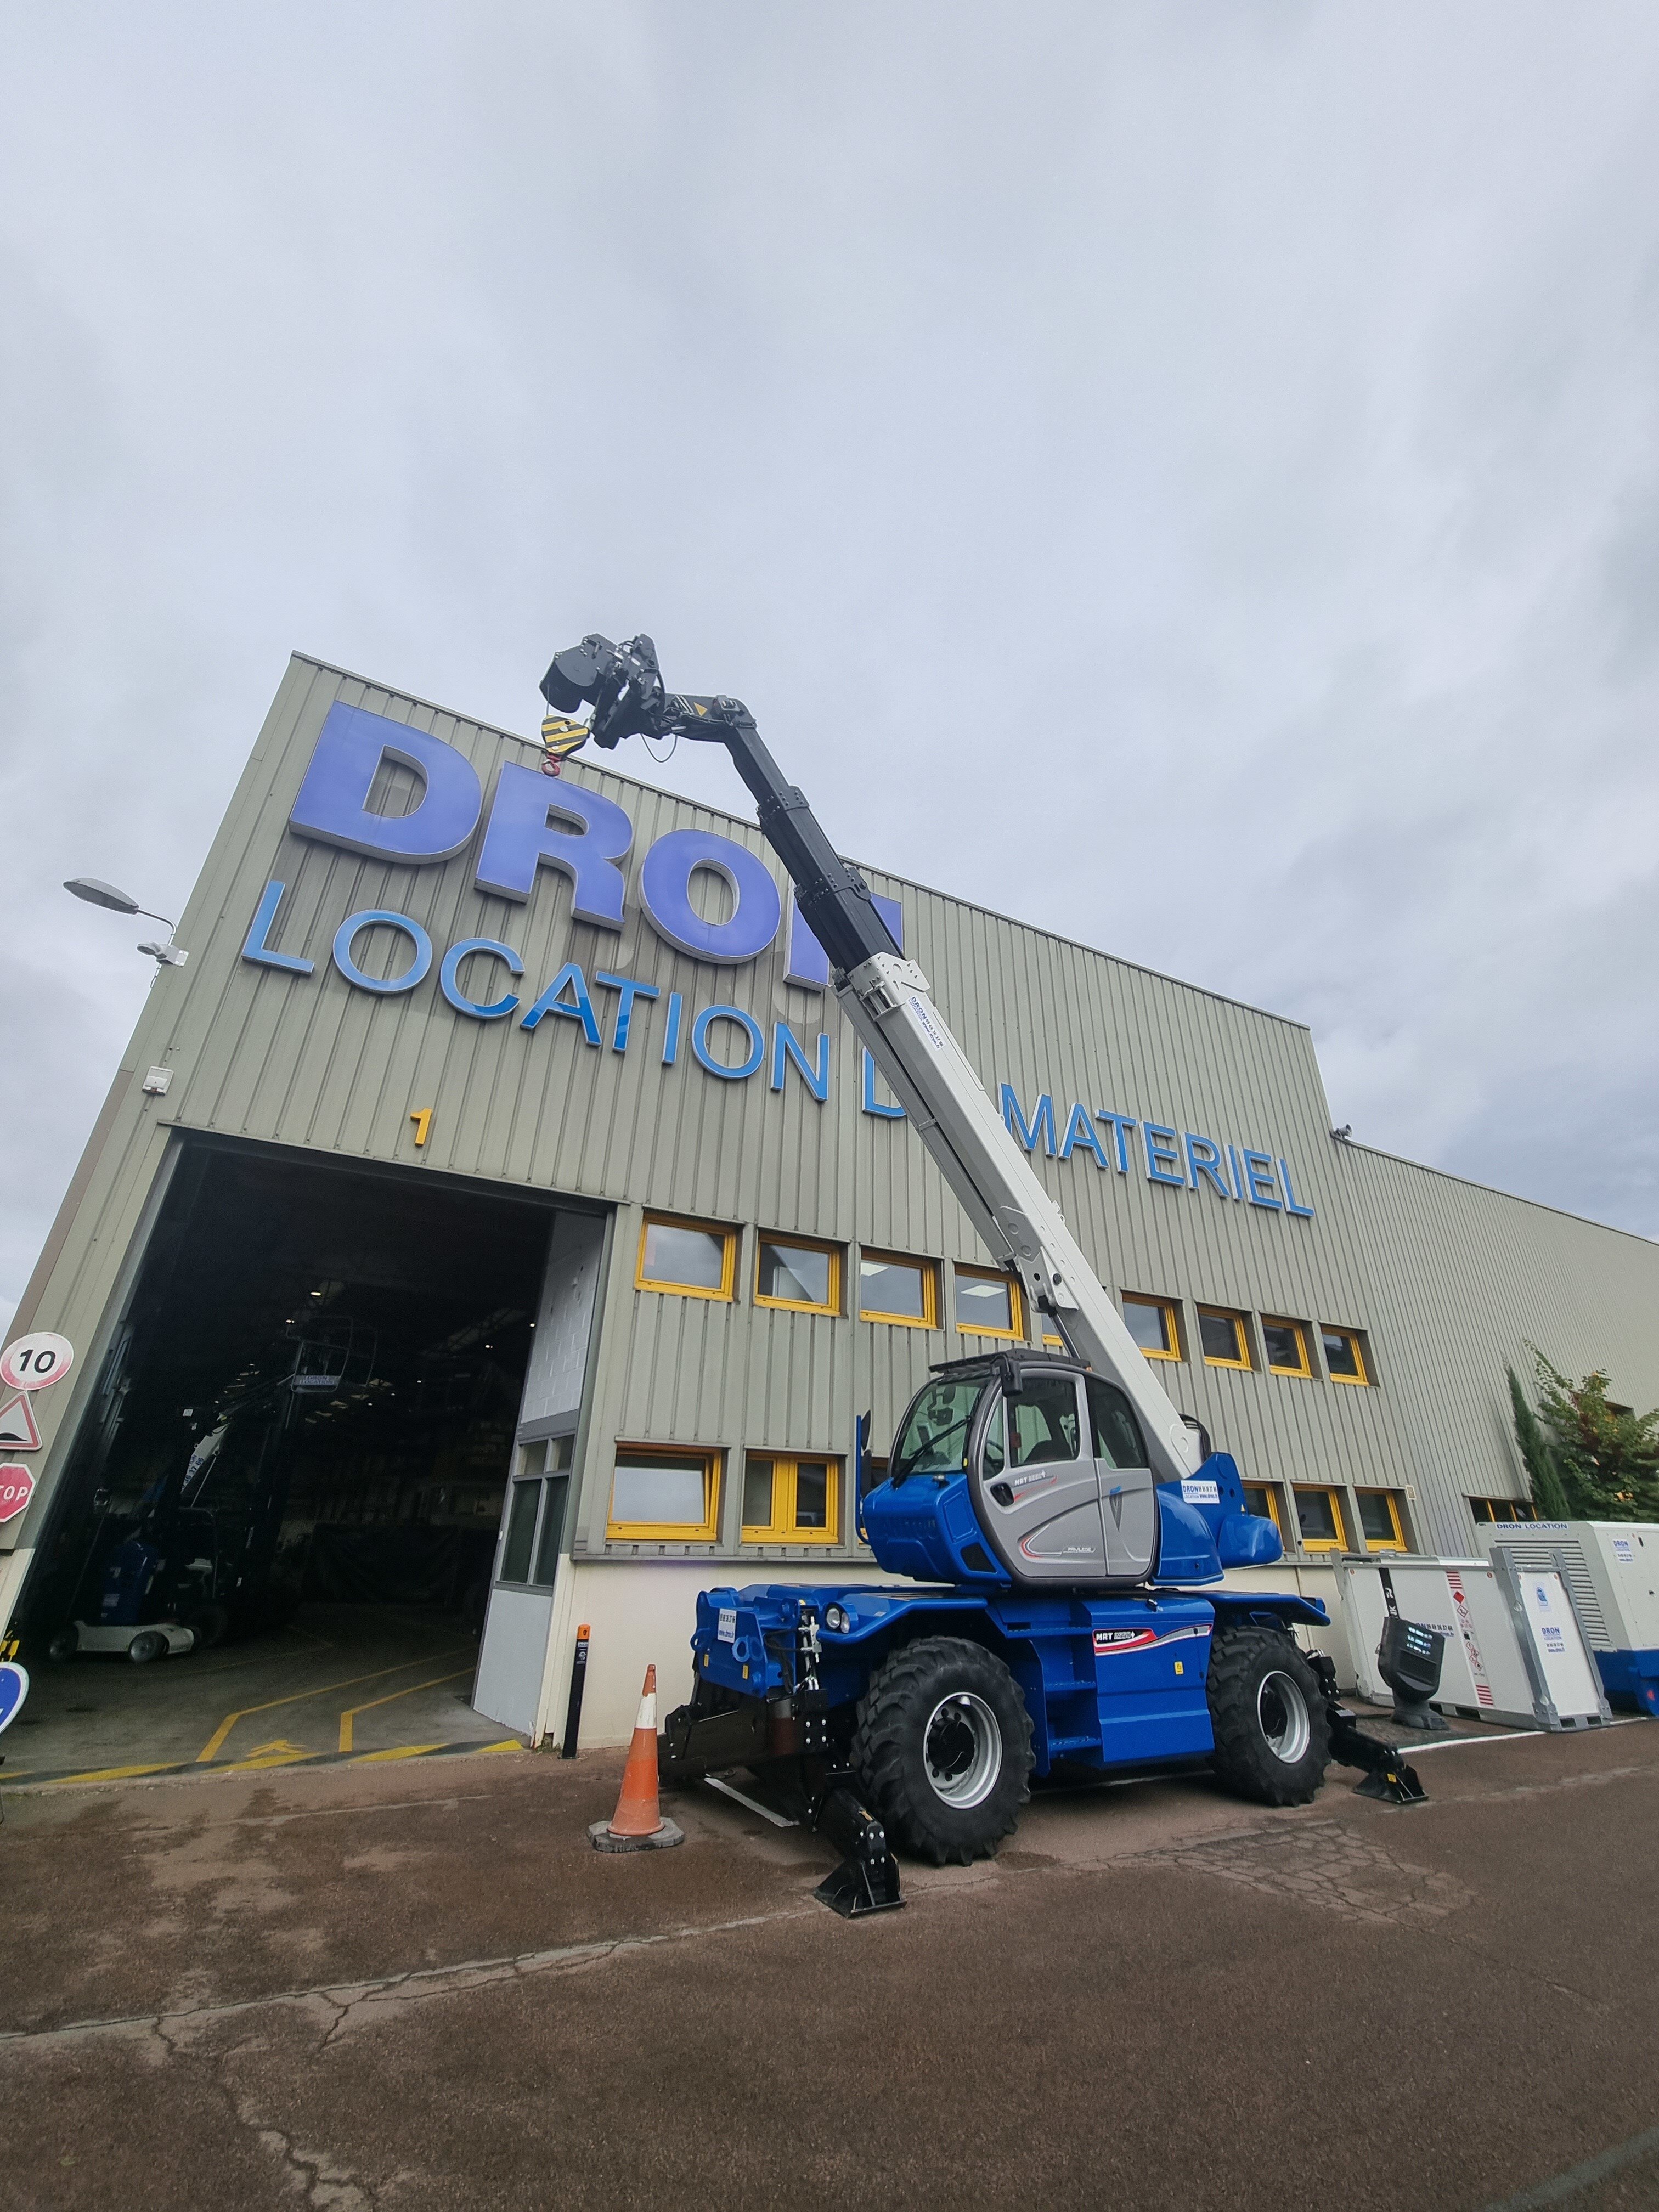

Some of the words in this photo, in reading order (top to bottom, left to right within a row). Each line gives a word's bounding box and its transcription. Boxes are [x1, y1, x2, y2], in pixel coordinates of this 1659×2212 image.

[911, 996, 927, 1019] DRON
[241, 879, 830, 1102] LOCATION
[998, 1082, 1314, 1218] MATERIEL
[410, 1107, 432, 1147] 1
[19, 1349, 56, 1373] 10
[1096, 1632, 1113, 1641] MRT
[1542, 1627, 1560, 1635] DRON
